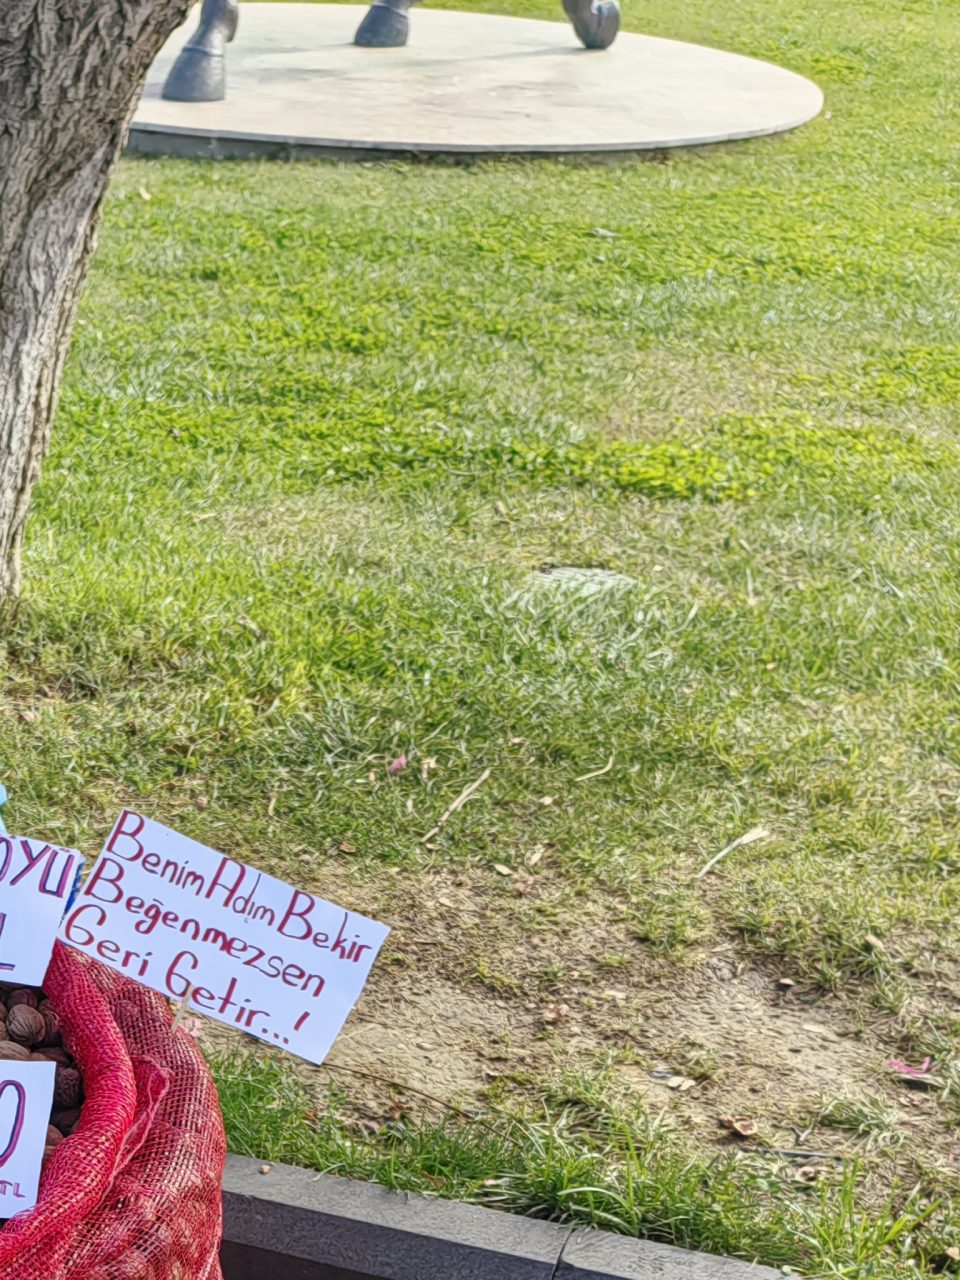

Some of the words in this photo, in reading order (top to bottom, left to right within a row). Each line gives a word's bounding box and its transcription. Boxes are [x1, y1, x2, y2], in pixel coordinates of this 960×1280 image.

[64, 903, 153, 977] Geri
[83, 857, 326, 998] Beğenmezsen
[105, 809, 205, 896] Benim
[277, 889, 372, 963] Bekir
